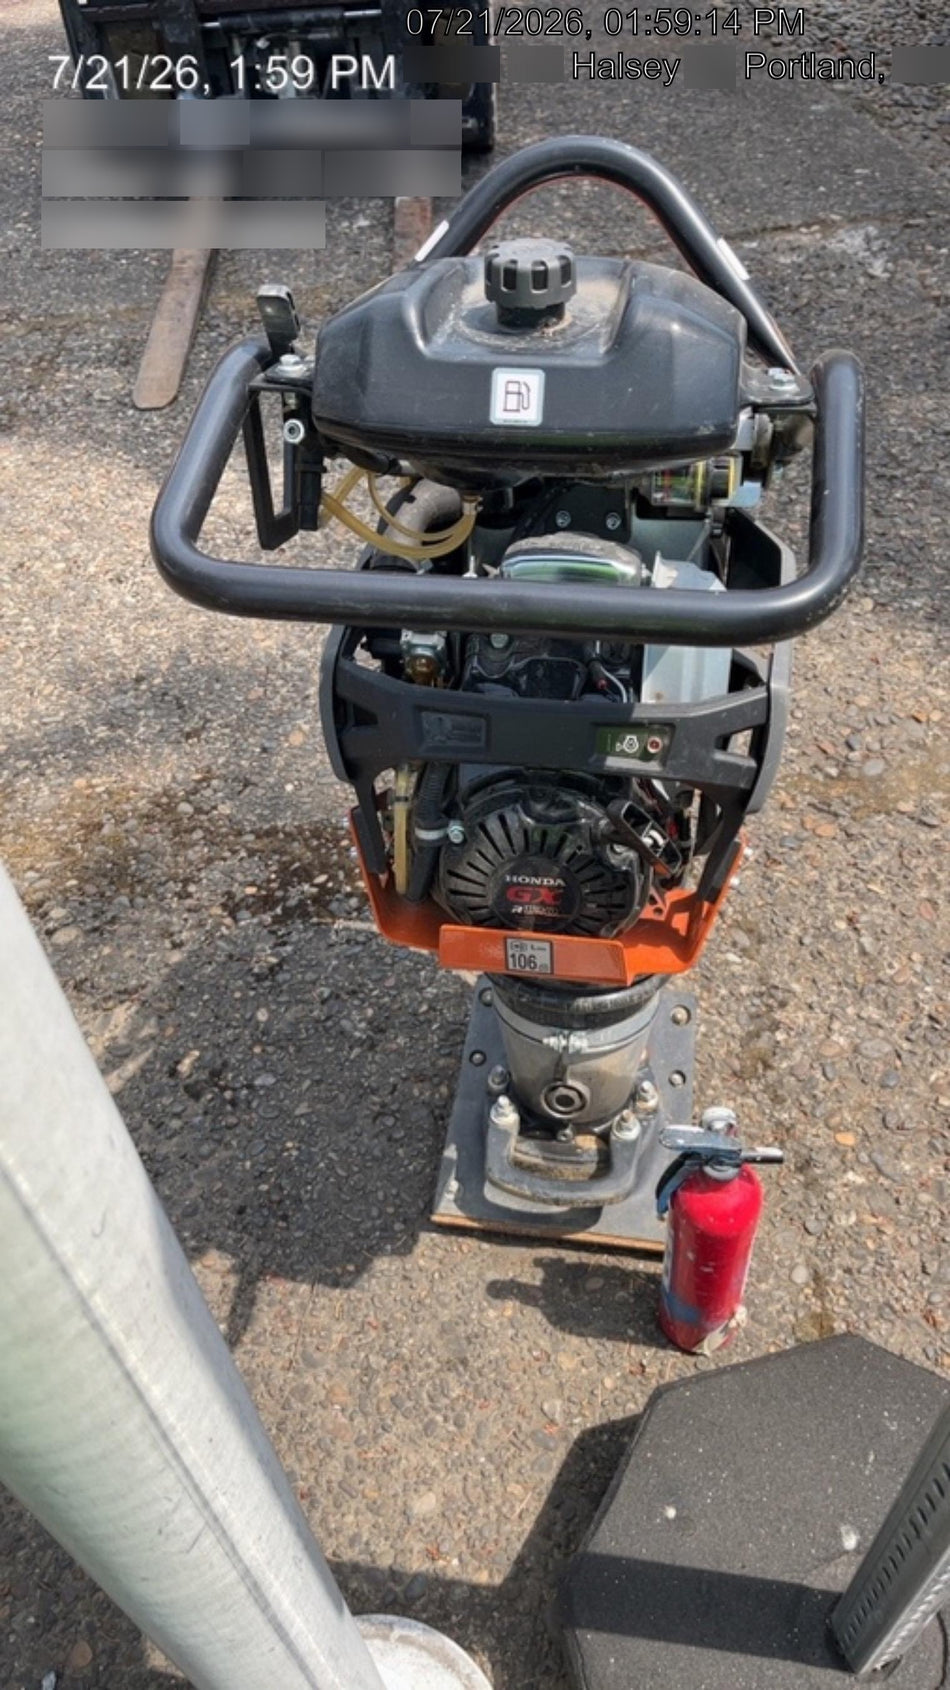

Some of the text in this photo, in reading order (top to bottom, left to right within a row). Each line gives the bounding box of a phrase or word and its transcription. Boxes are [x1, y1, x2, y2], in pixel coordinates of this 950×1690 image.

[505, 874, 566, 887] HONDA
[506, 886, 561, 905] GX
[510, 953, 538, 969] 106
